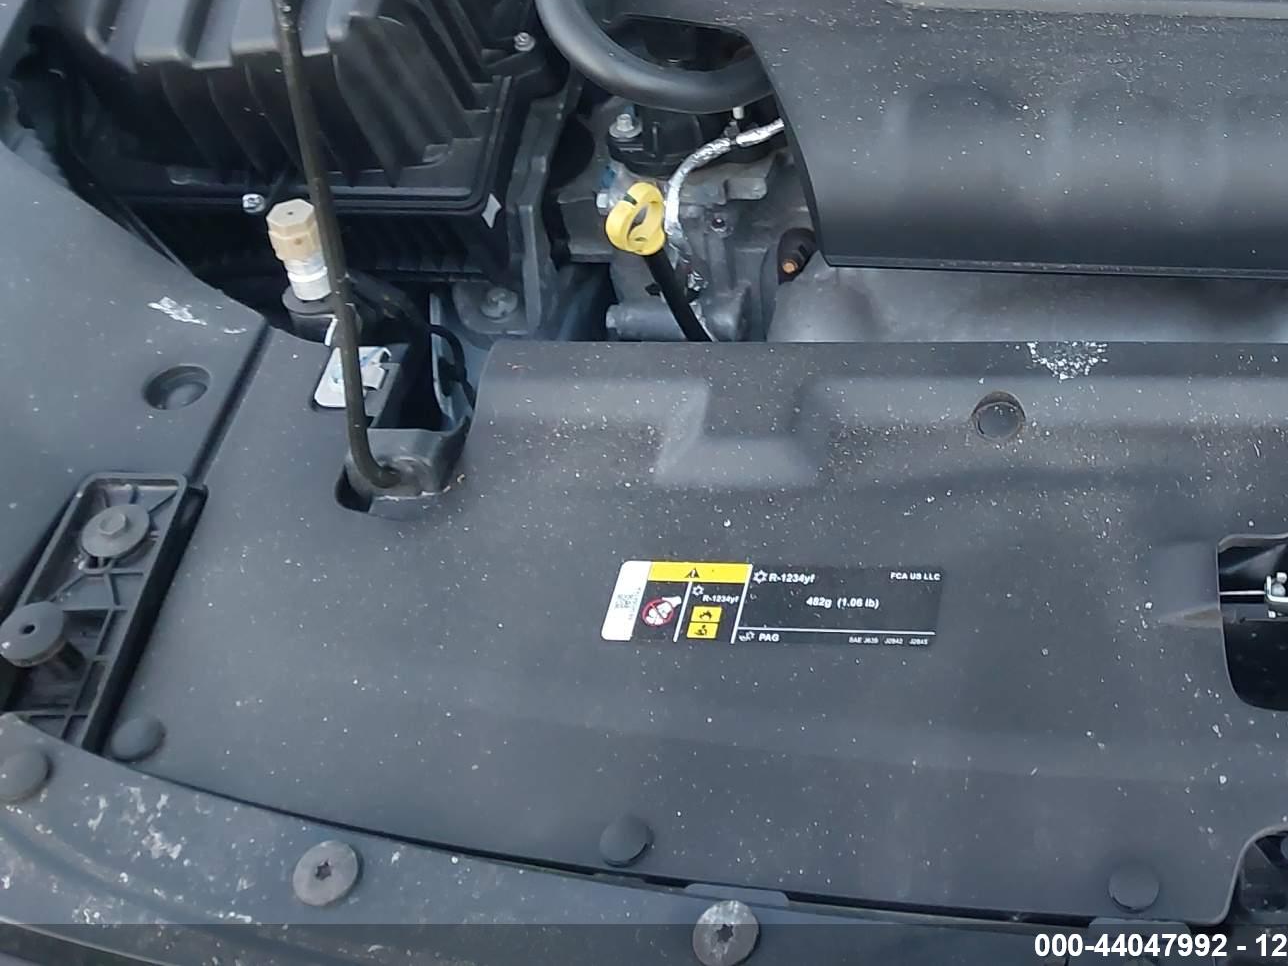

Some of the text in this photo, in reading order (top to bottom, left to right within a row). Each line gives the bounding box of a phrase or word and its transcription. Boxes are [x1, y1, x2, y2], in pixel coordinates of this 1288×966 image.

[769, 573, 815, 585] R-1234yf
[890, 571, 941, 582] FCA US LLC
[702, 594, 740, 605] R-1234yf
[806, 596, 833, 609] 482g
[864, 597, 880, 610] lb)
[758, 632, 780, 642] PAG
